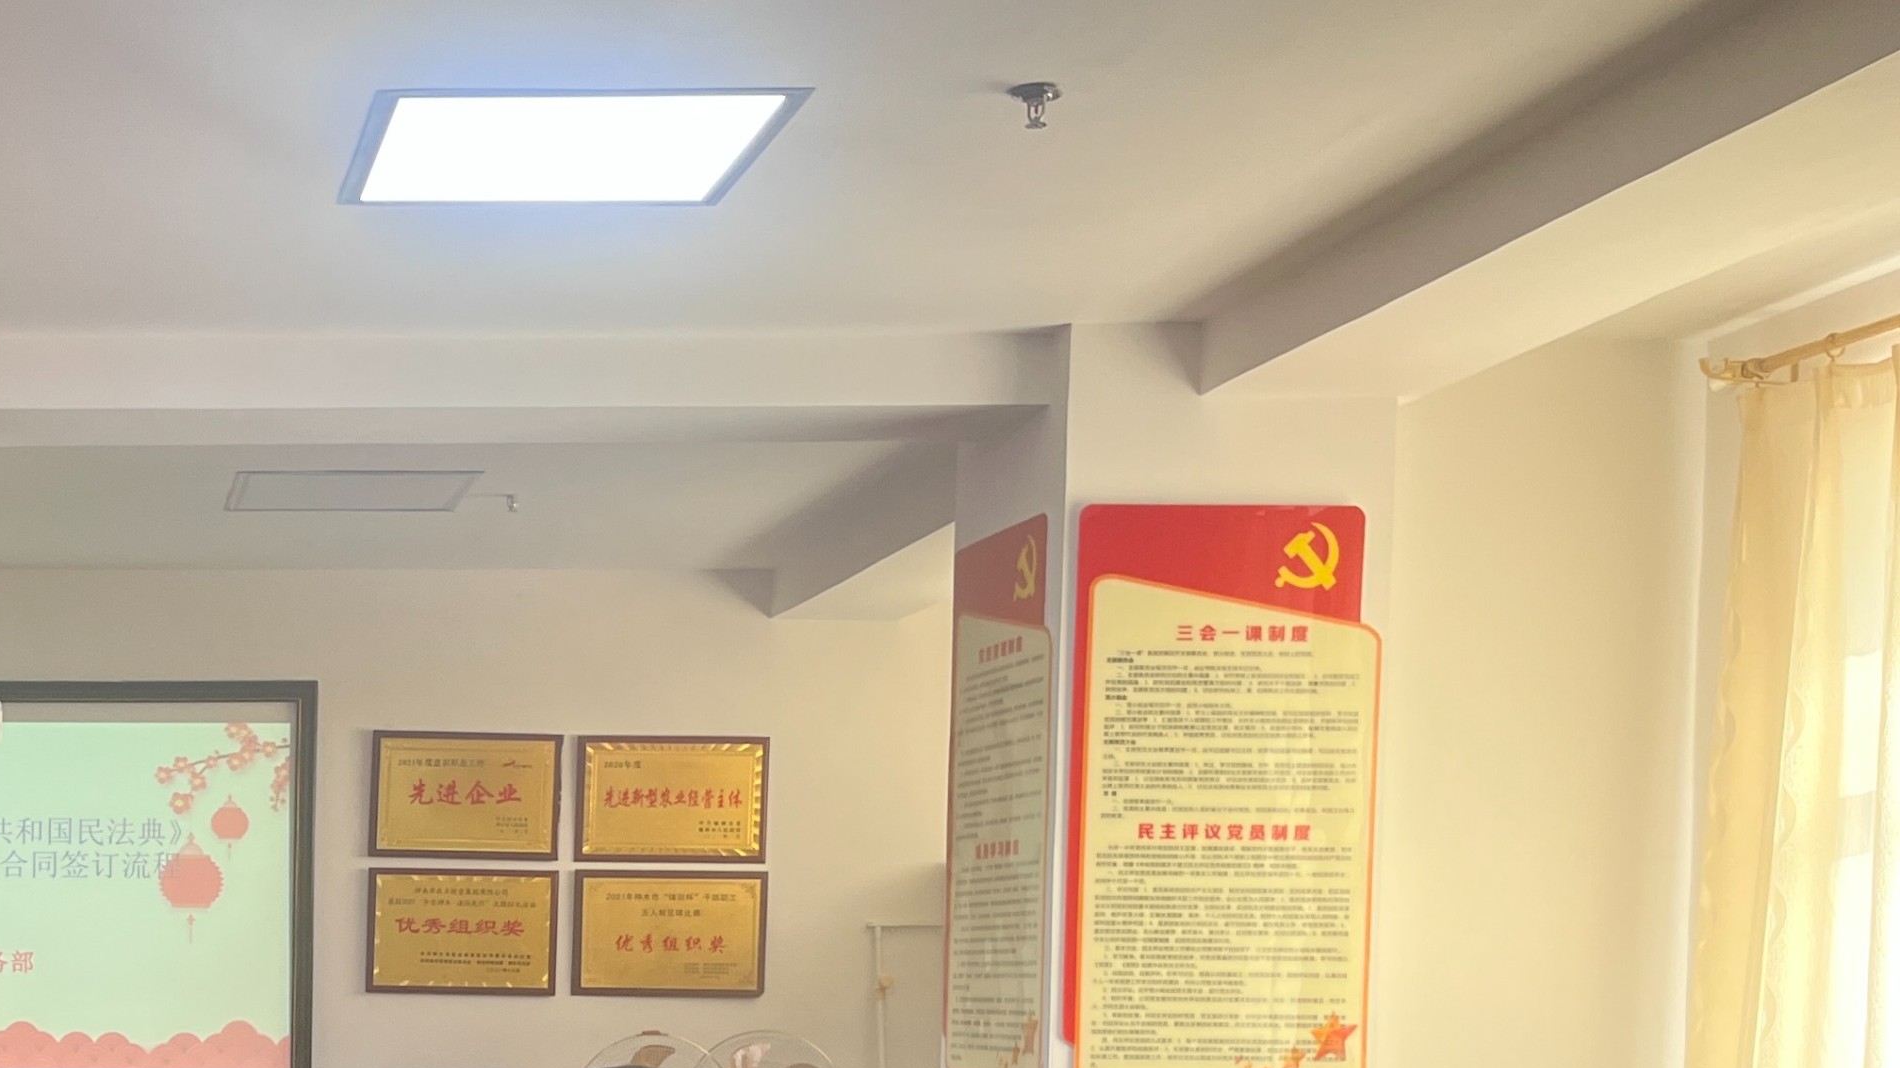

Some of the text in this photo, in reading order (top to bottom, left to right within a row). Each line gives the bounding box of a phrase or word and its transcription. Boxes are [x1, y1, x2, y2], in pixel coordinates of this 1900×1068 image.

[1176, 624, 1309, 642] 三会一课制度
[408, 779, 522, 805] 先进企业
[603, 786, 742, 809] 先进新型农业经营主体
[1138, 823, 1312, 841] 民主评议党员制度
[395, 917, 525, 937] 优秀组织奖
[615, 934, 725, 954] 优秀组织奖
